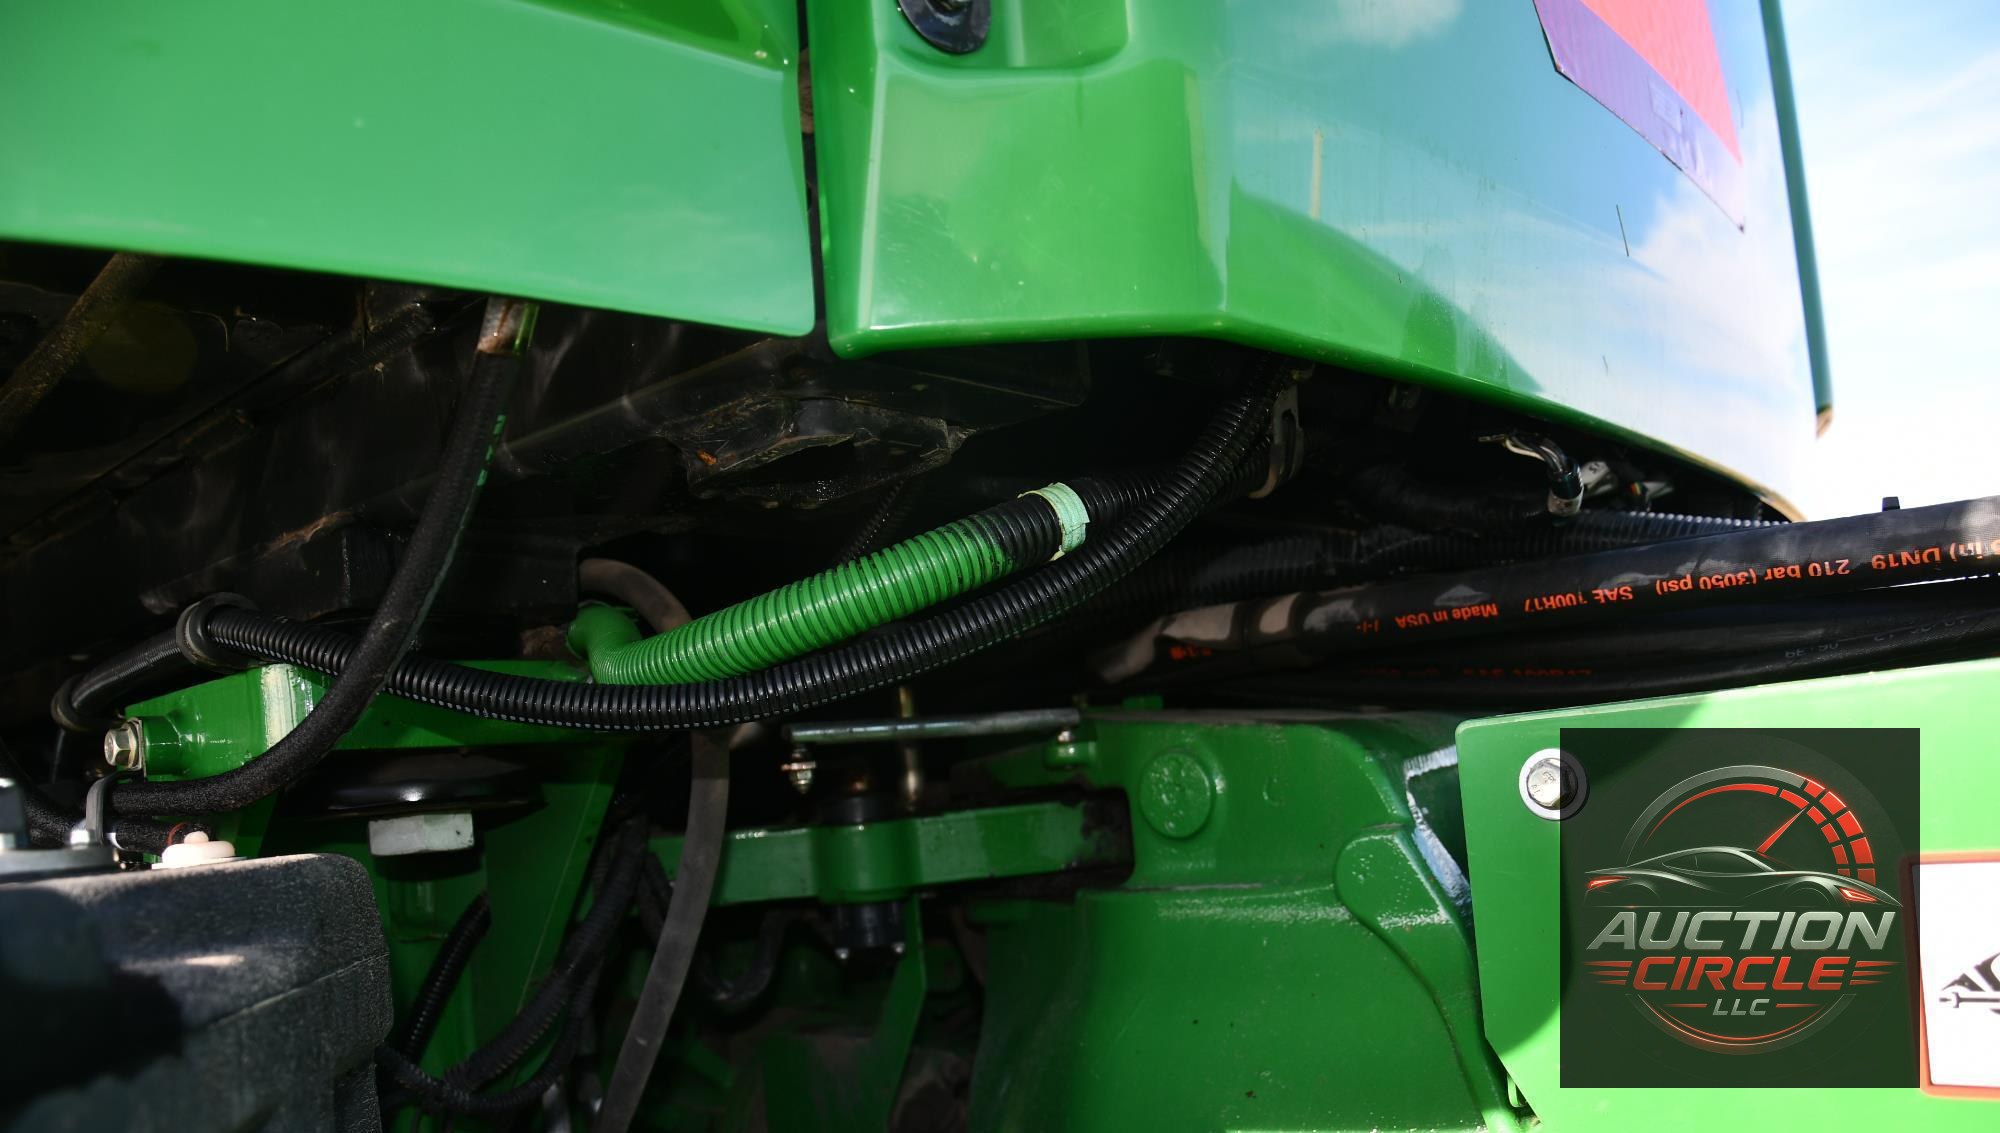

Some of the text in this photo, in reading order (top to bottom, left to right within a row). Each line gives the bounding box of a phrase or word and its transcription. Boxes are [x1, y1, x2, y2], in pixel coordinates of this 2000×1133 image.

[1808, 558, 1850, 577] 210
[1871, 546, 1941, 570] DN19
[1698, 569, 1757, 591] (3050
[1764, 564, 1801, 581] bar
[1655, 574, 1694, 596] psi)
[1592, 585, 1634, 605] SAE
[1395, 612, 1429, 629] USA
[1432, 610, 1448, 623] in
[1452, 602, 1499, 621] Made
